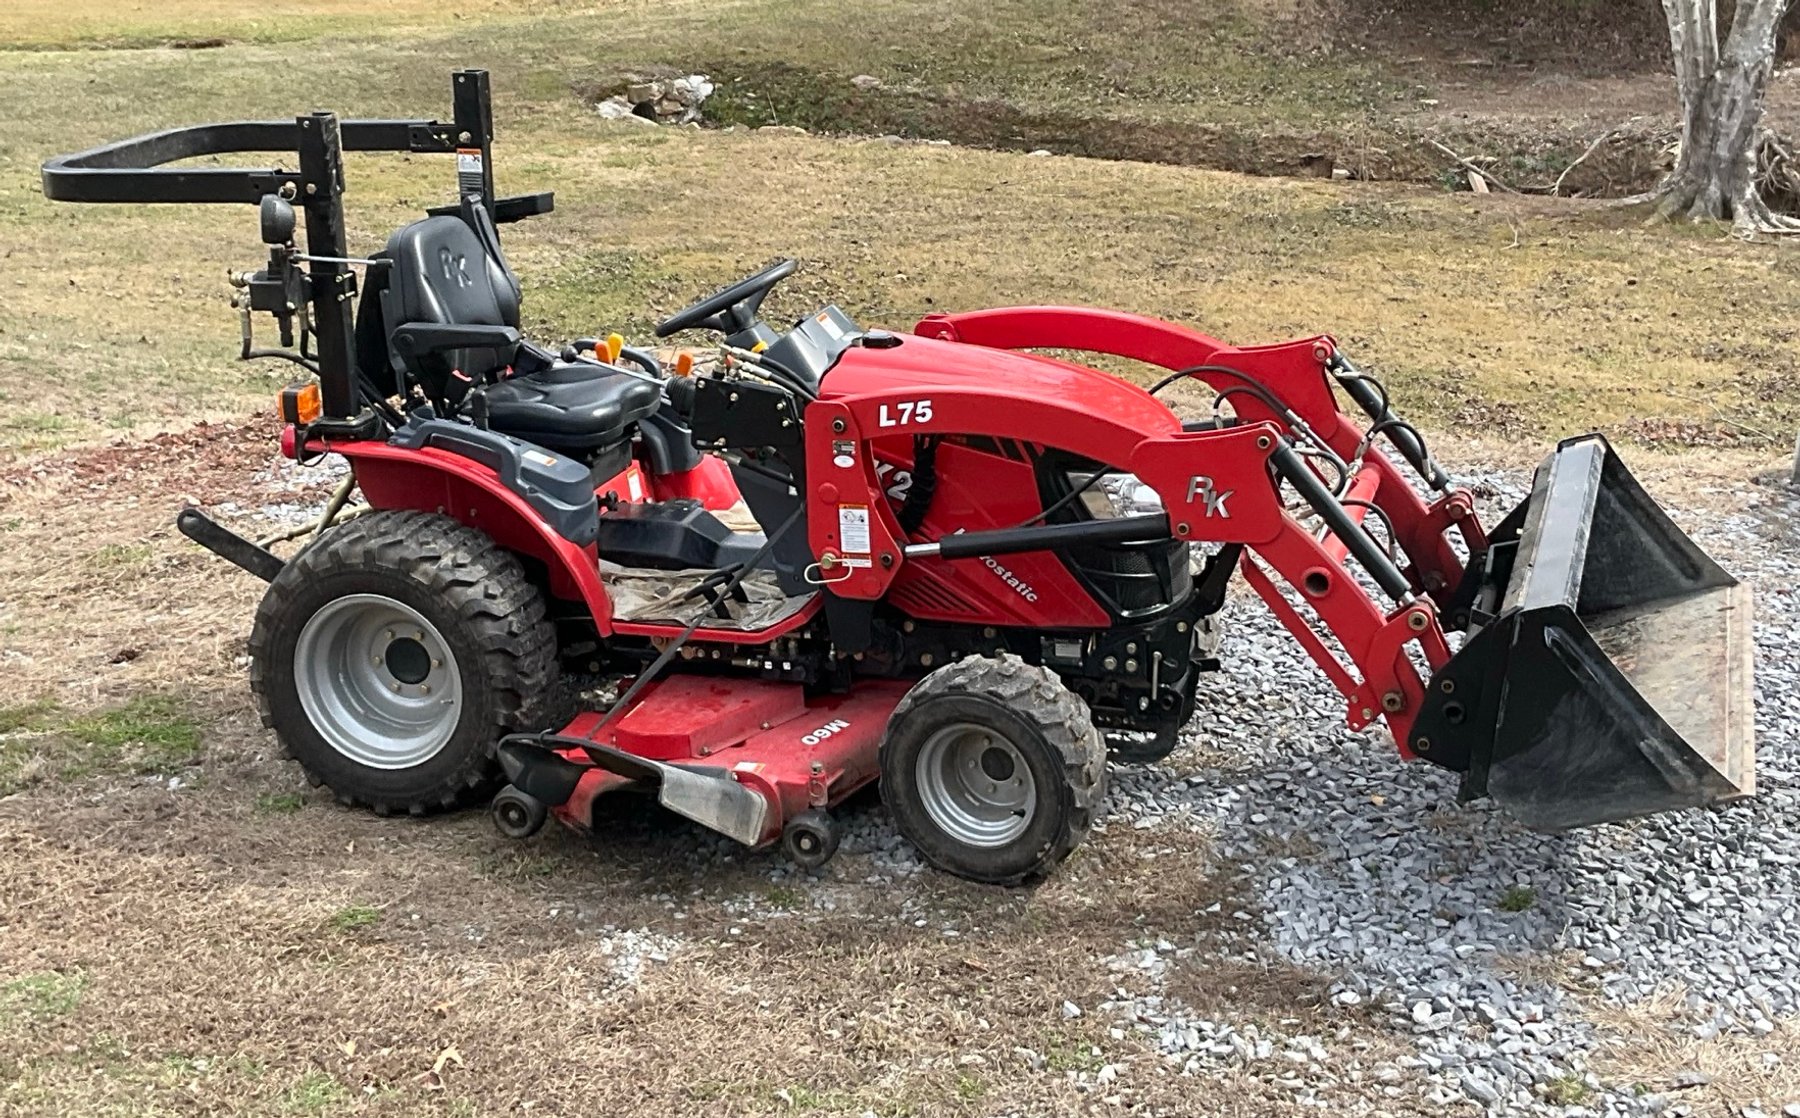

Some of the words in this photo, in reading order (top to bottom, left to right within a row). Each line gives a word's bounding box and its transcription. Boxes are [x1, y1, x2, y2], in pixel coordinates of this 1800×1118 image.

[438, 246, 472, 288] RK
[879, 400, 933, 427] L75
[1186, 475, 1235, 518] RK
[801, 719, 851, 746] M60
